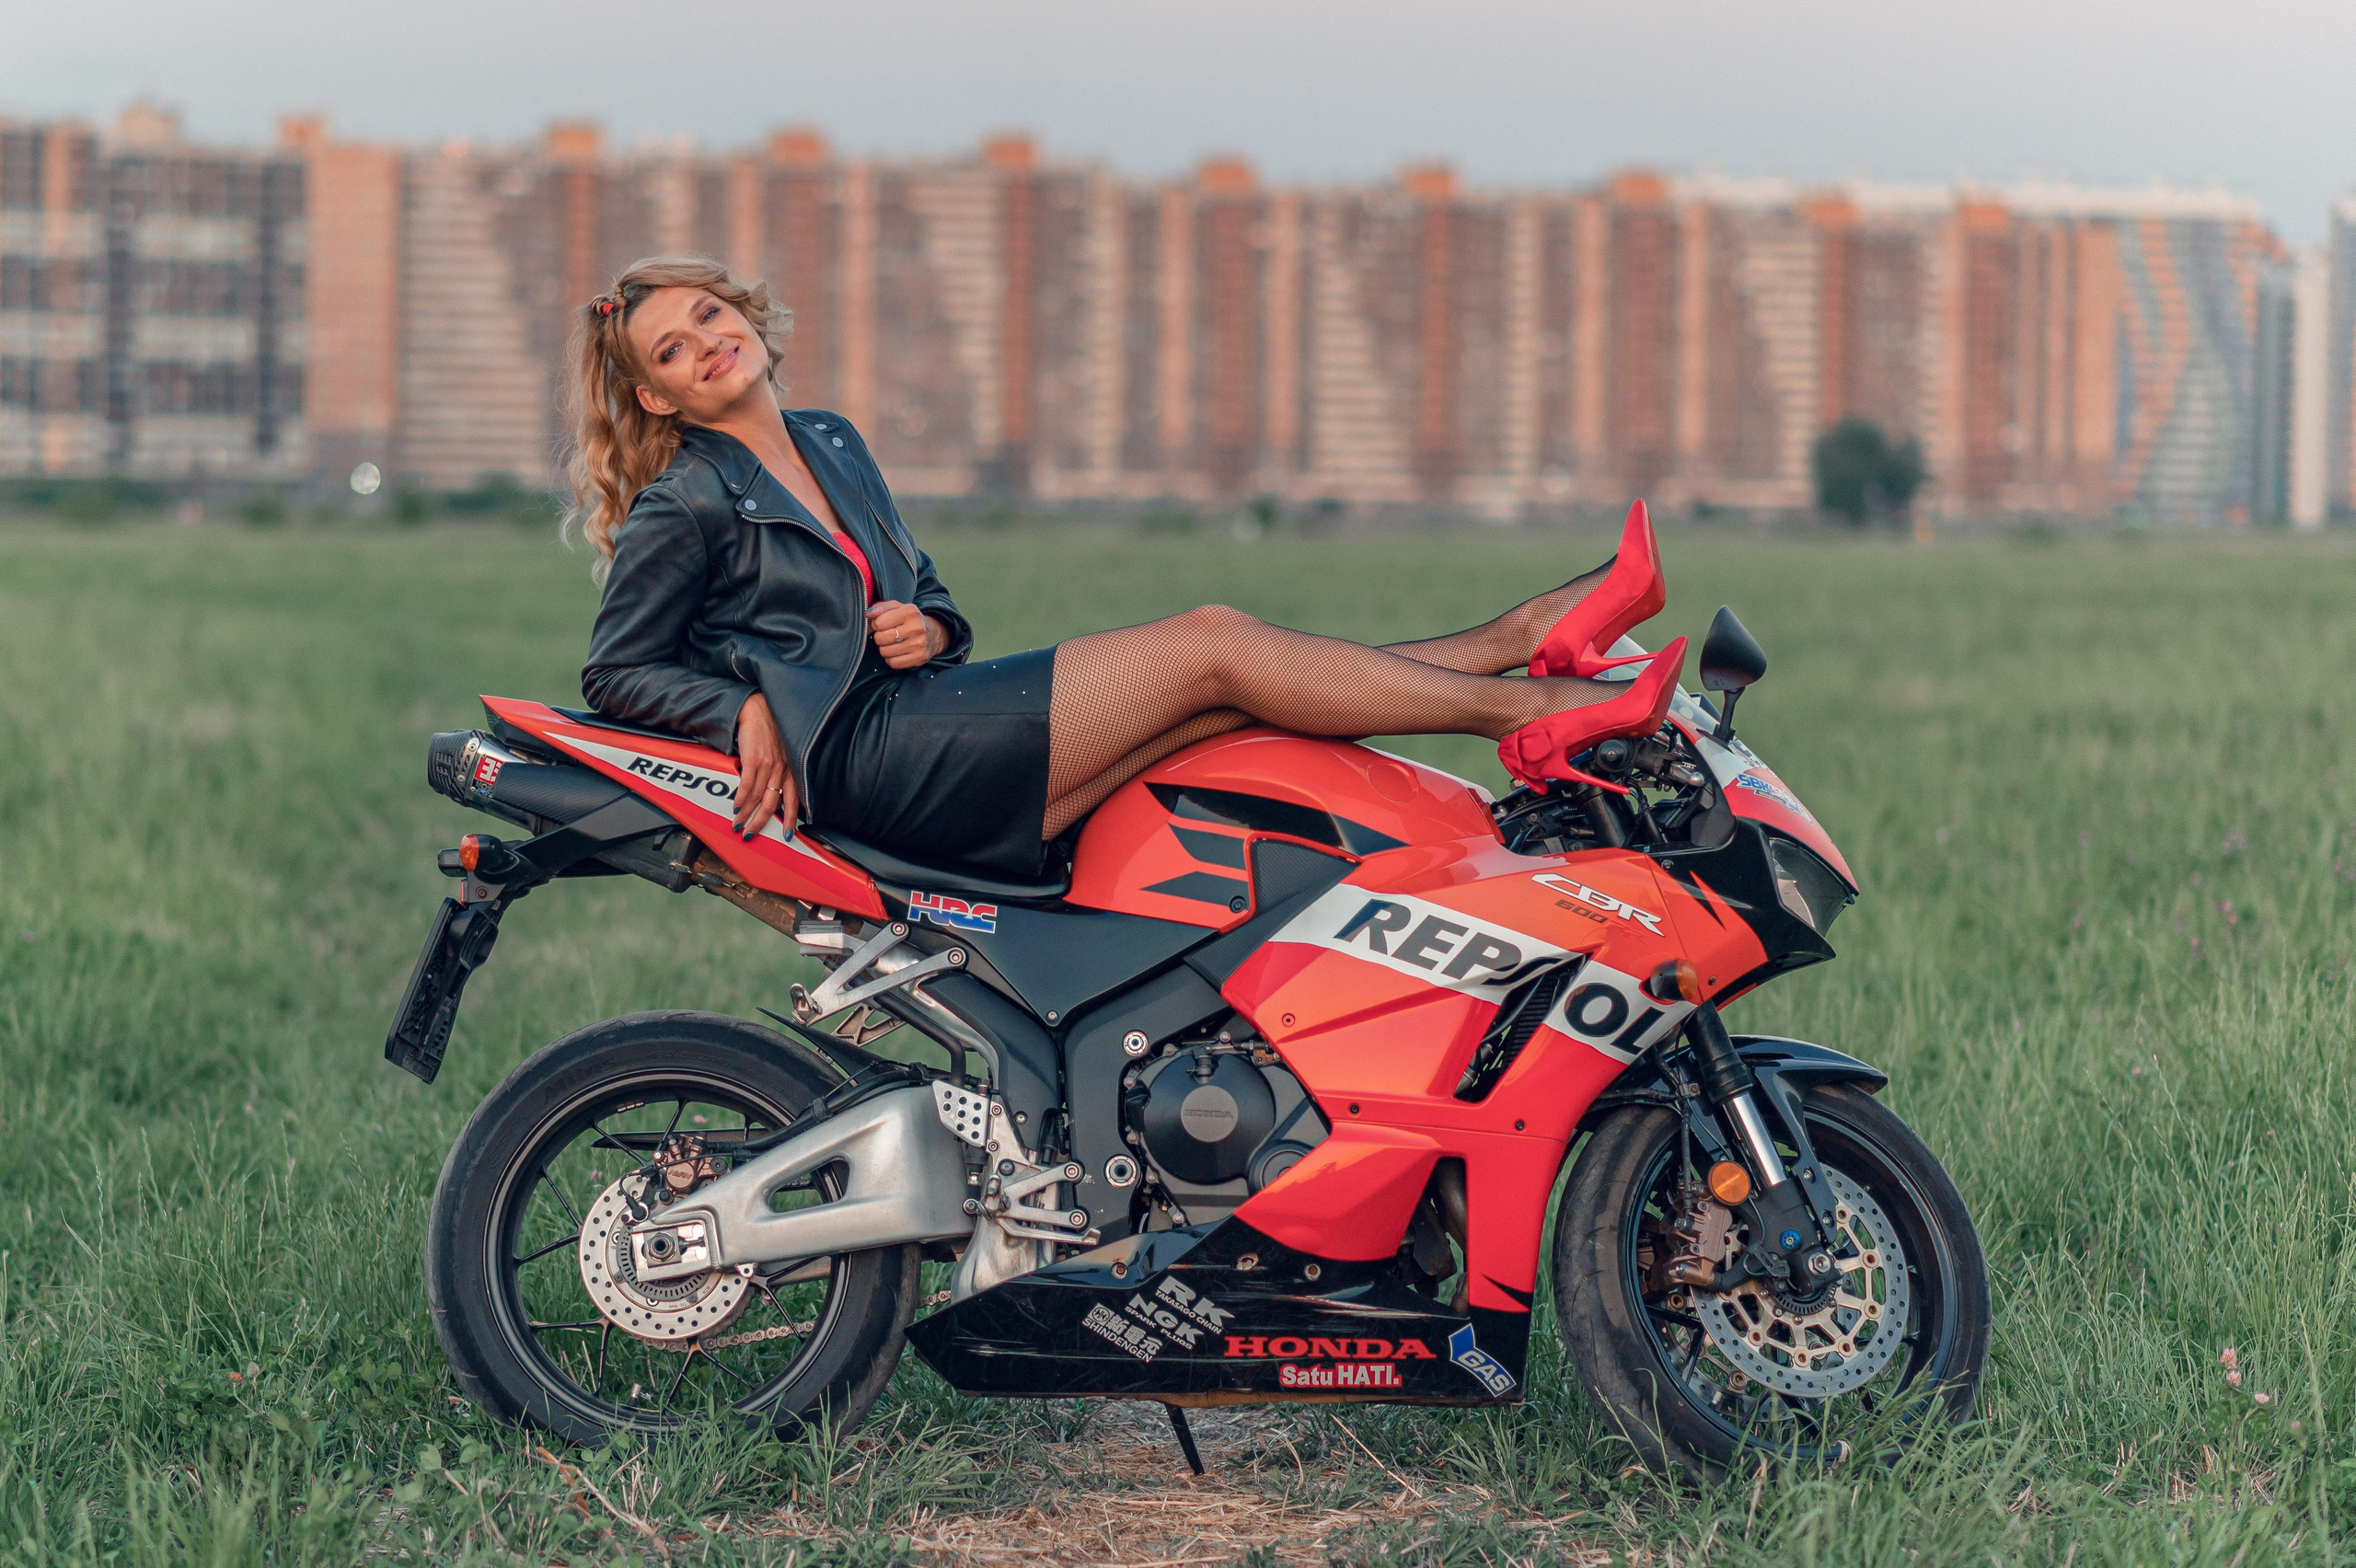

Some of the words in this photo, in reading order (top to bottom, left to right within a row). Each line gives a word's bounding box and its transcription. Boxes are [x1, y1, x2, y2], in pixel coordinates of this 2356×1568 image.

[907, 890, 998, 934] HRC
[1530, 872, 1666, 938] CBR
[1554, 899, 1609, 923] 600
[1333, 898, 1666, 1055] REPSOL
[1184, 1109, 1234, 1119] HONDA
[1128, 1293, 1205, 1345] NGK
[1155, 1289, 1196, 1319] TAKASAGO
[1196, 1316, 1223, 1334] CHAIN
[1158, 1274, 1235, 1327] RK
[1081, 1317, 1153, 1363] SHINDENGEN
[1125, 1305, 1158, 1329] SPARK
[1160, 1328, 1194, 1350] PLUGS
[1223, 1335, 1437, 1359] HONDA
[1282, 1365, 1333, 1385] Satu
[1337, 1365, 1400, 1385] HATI.
[1458, 1350, 1509, 1391] GAS
